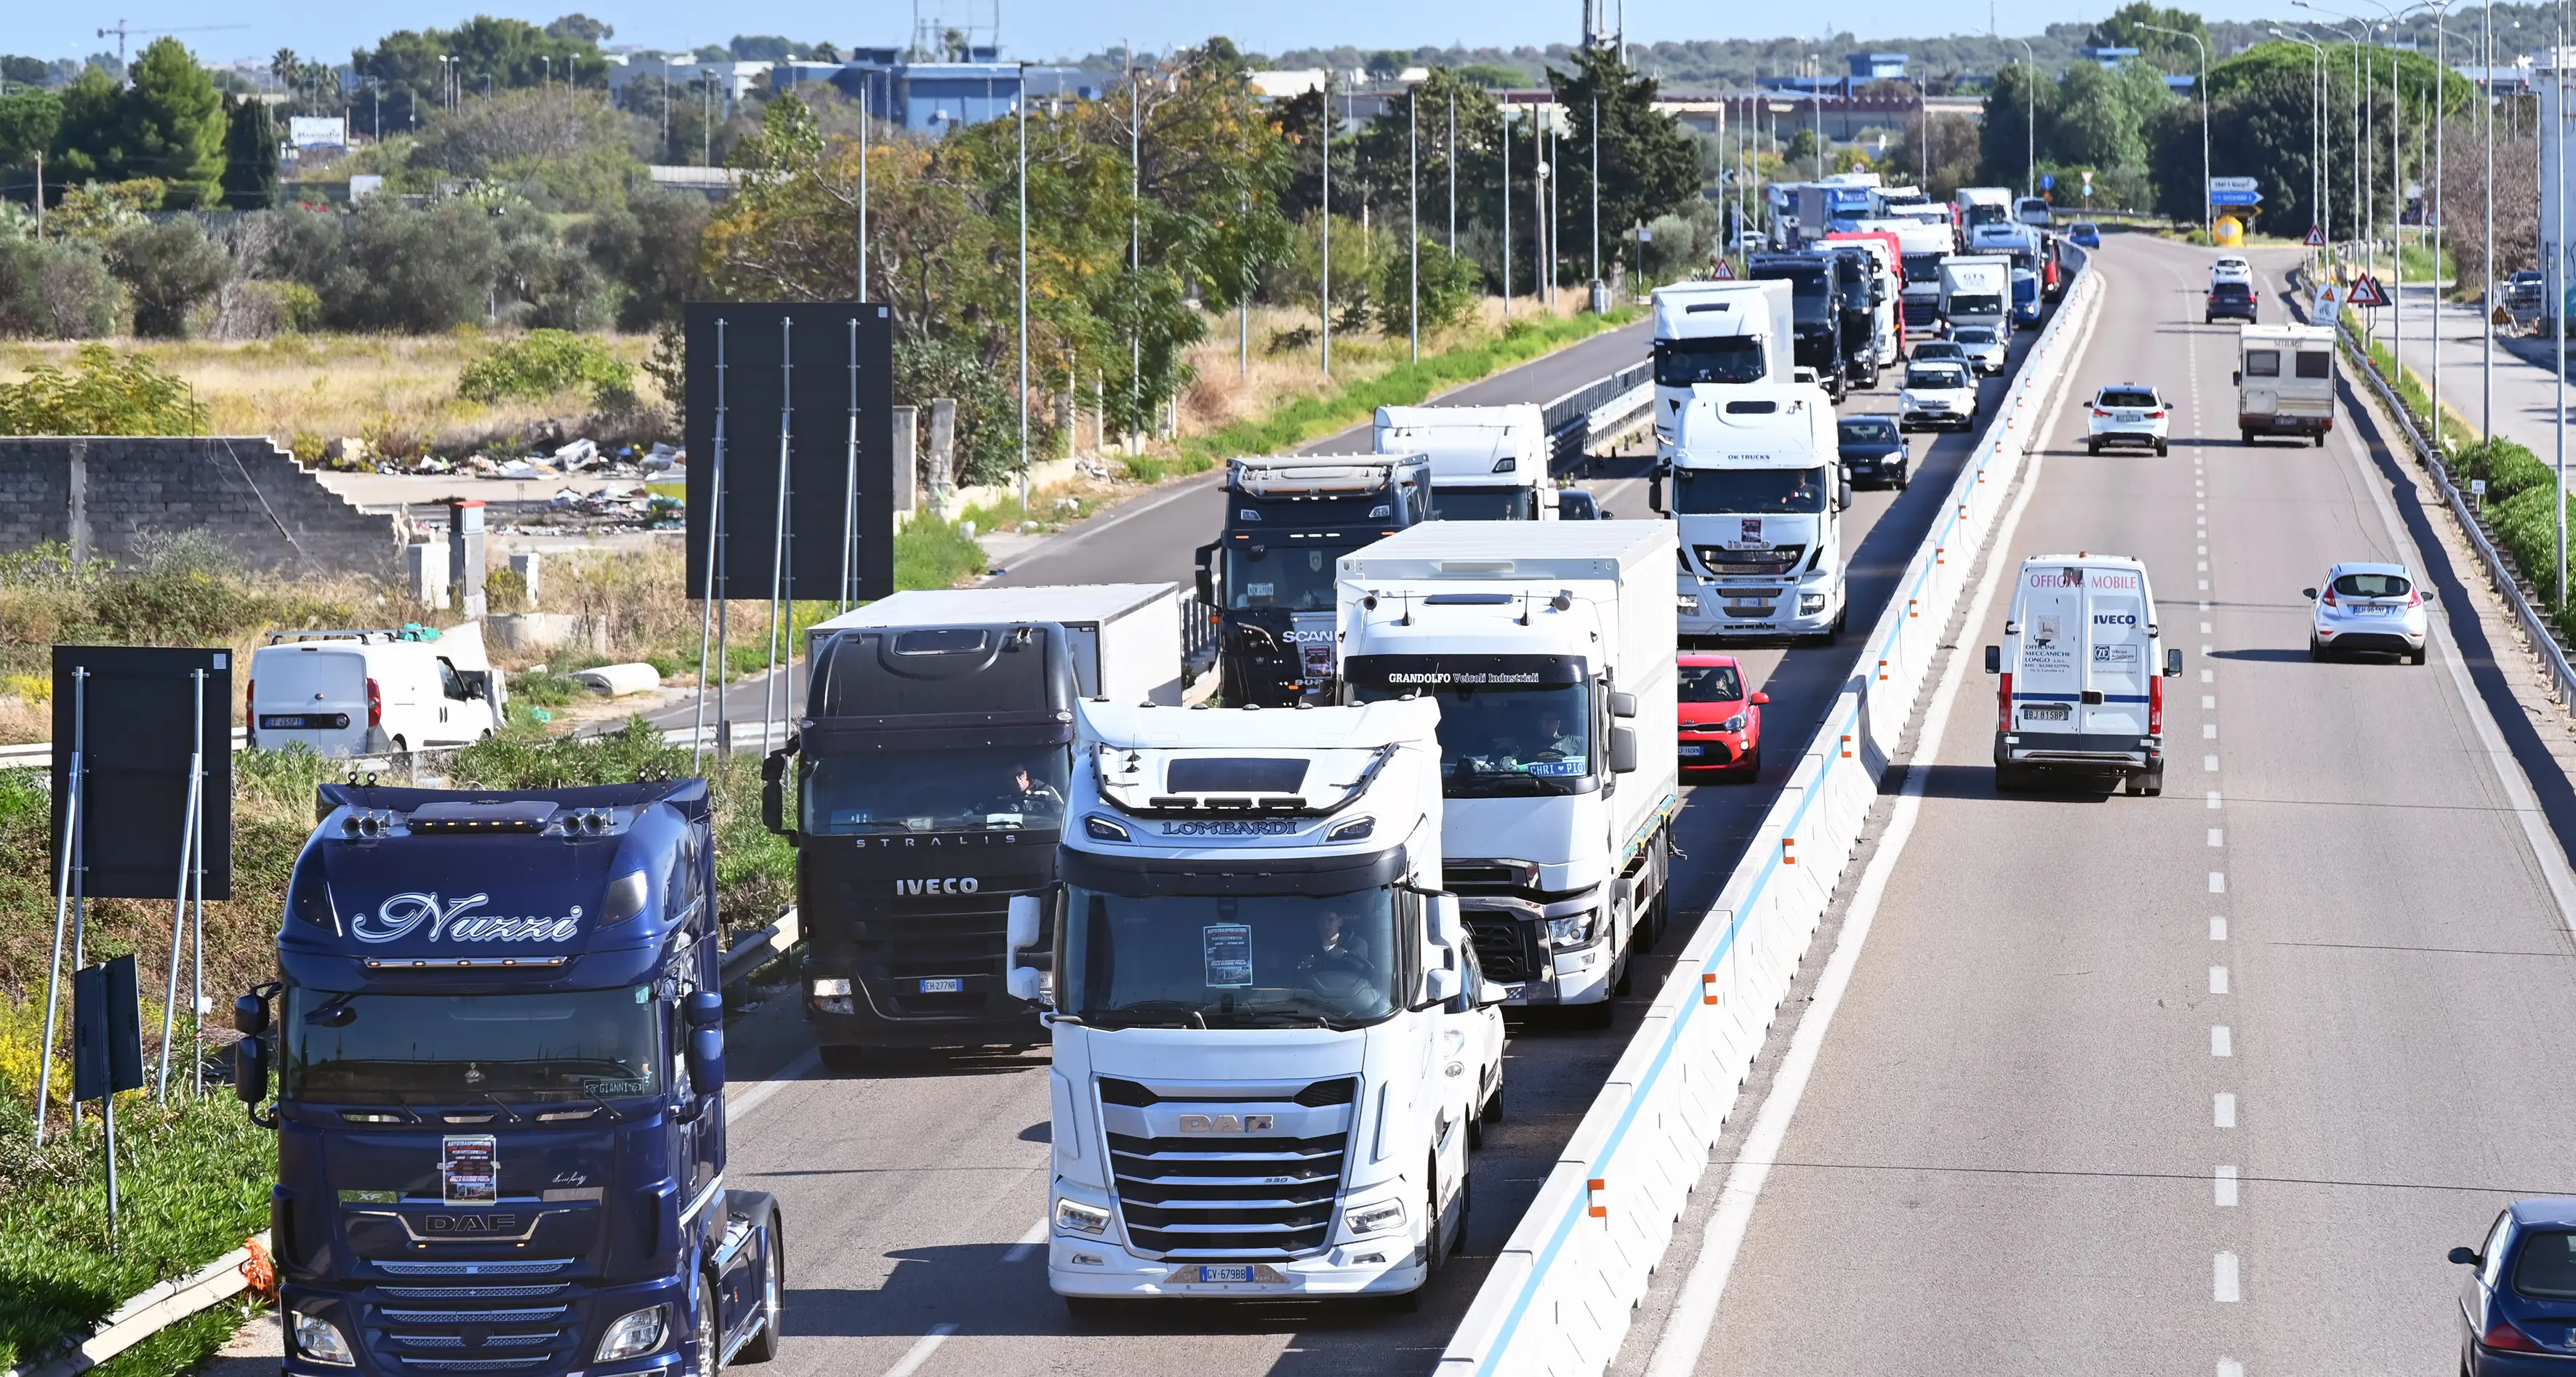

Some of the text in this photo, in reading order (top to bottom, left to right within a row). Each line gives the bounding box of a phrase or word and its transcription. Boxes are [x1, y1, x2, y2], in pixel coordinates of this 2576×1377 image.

[2274, 340, 2302, 348] MIRAGE
[2091, 576, 2136, 589] MOBILE
[2094, 615, 2136, 625] IVECO
[1283, 630, 1337, 643] SCANI
[1389, 673, 1539, 683] GRANDOLFO Veicoli Industriali
[2040, 711, 2063, 720] 815BP
[1530, 764, 1554, 775] CHRI
[1162, 821, 1297, 835] LOMBARDI
[856, 835, 1016, 848] STRALIS
[896, 877, 979, 896] IVECO
[351, 891, 583, 944] Nuzzi
[926, 981, 956, 990] EH 277NR
[599, 1081, 629, 1093] GIANNI
[1179, 1115, 1274, 1133] DAF
[358, 1192, 384, 1201] XF
[425, 1214, 515, 1232] DAF
[1207, 1269, 1217, 1279] GV
[1221, 1269, 1246, 1279] 679BB
